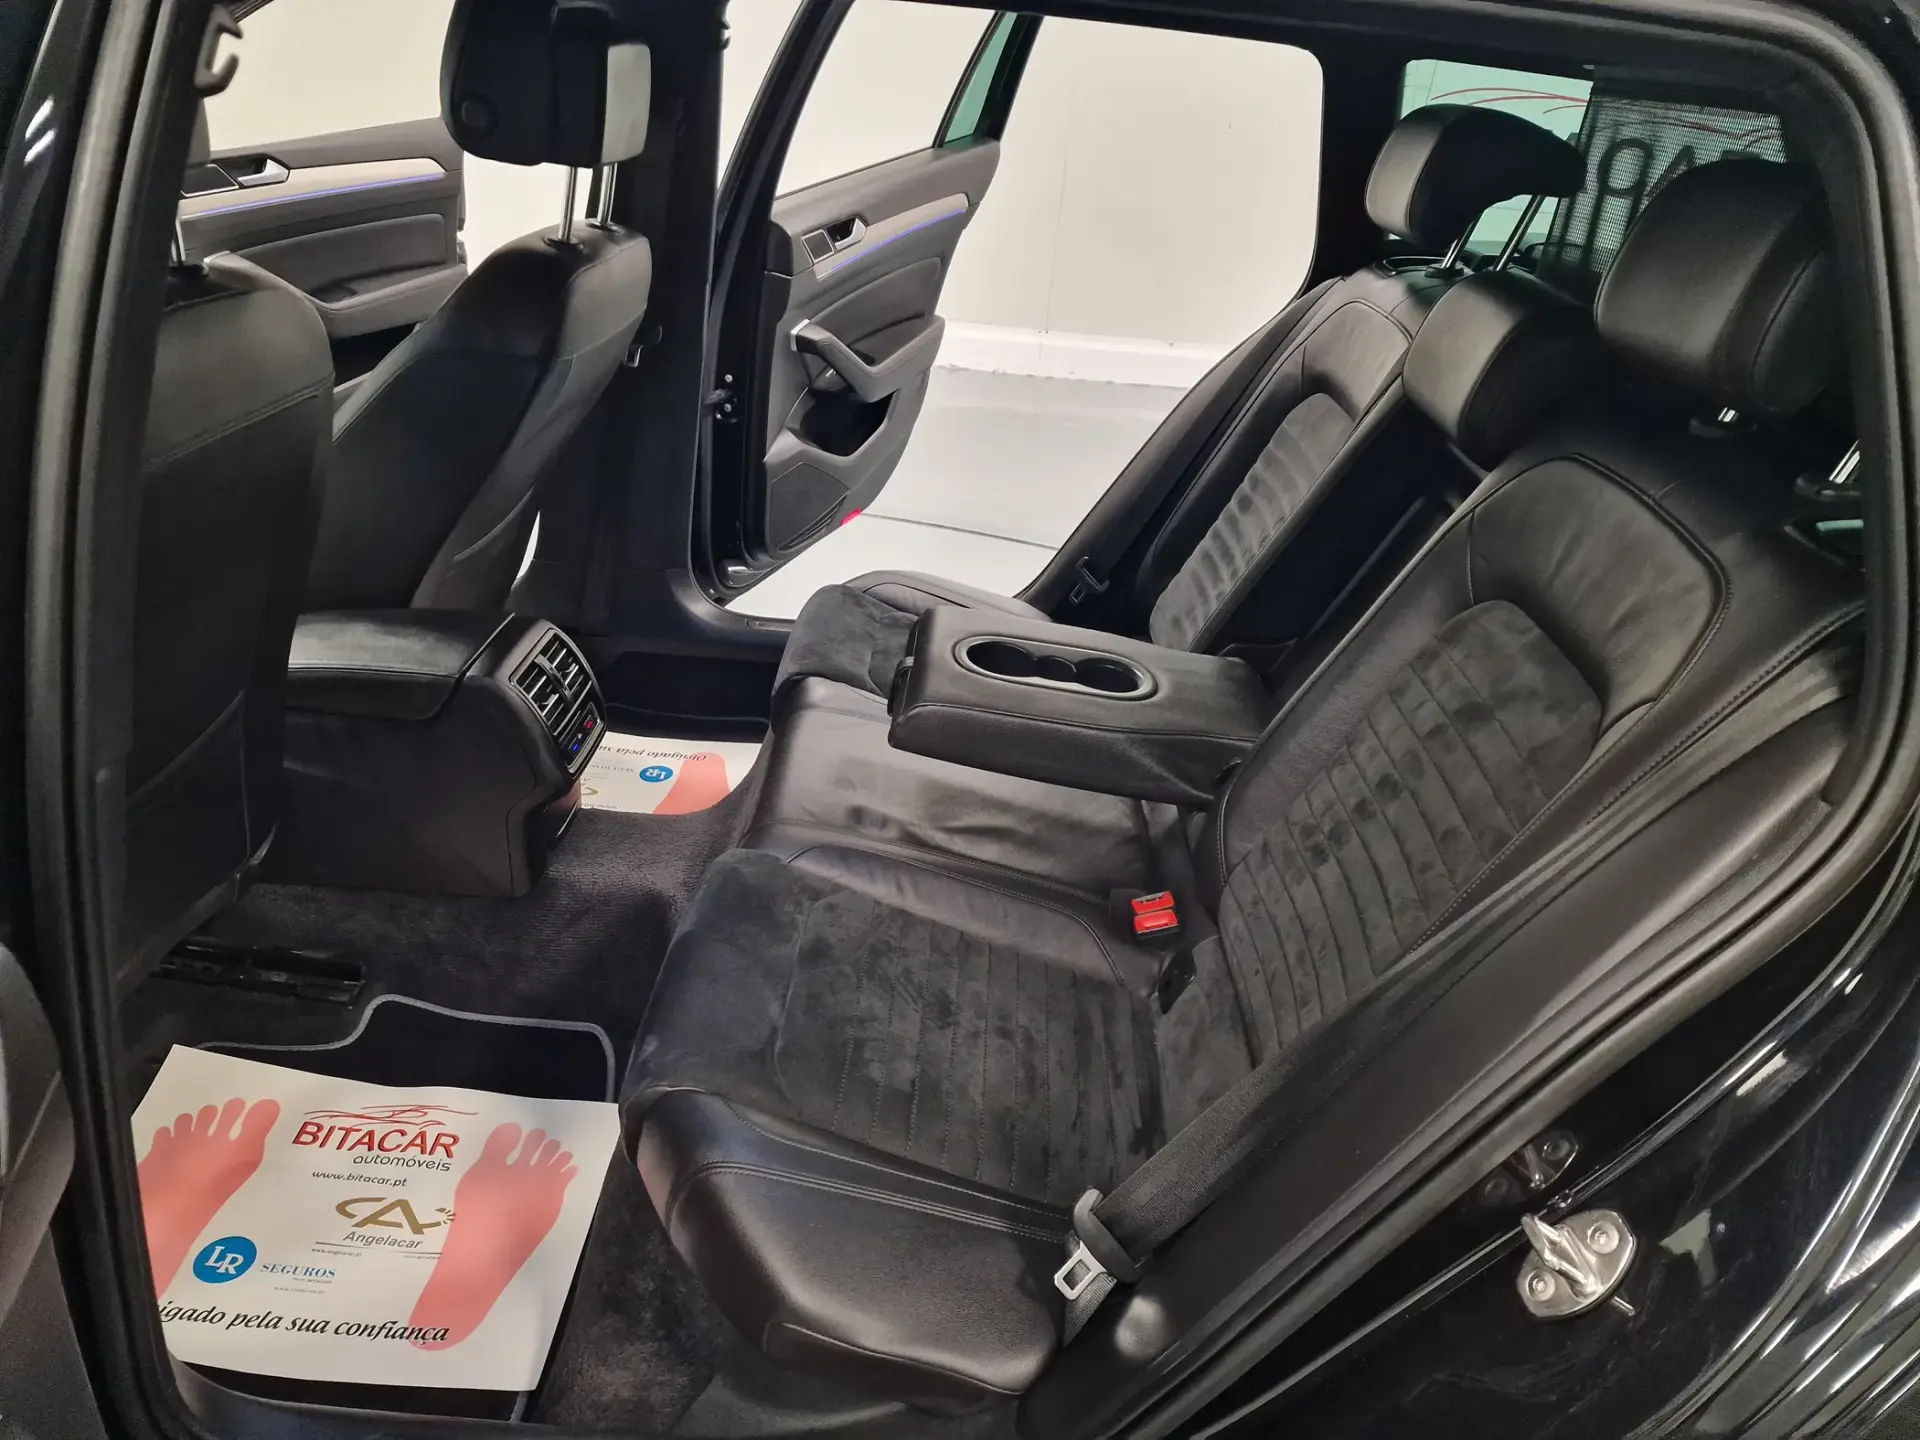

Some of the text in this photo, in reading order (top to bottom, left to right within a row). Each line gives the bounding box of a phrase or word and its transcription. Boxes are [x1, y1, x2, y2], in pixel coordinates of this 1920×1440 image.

[616, 747, 646, 756] pela
[645, 768, 667, 780] LR
[292, 1121, 460, 1159] BITACAR
[353, 1154, 452, 1172] automóveis
[312, 1170, 408, 1188] www.bitacar.pt
[342, 1231, 424, 1249] Angelacar
[204, 1245, 338, 1279] LR SEGUROS
[158, 1300, 450, 1346] igado pela sua confiança
